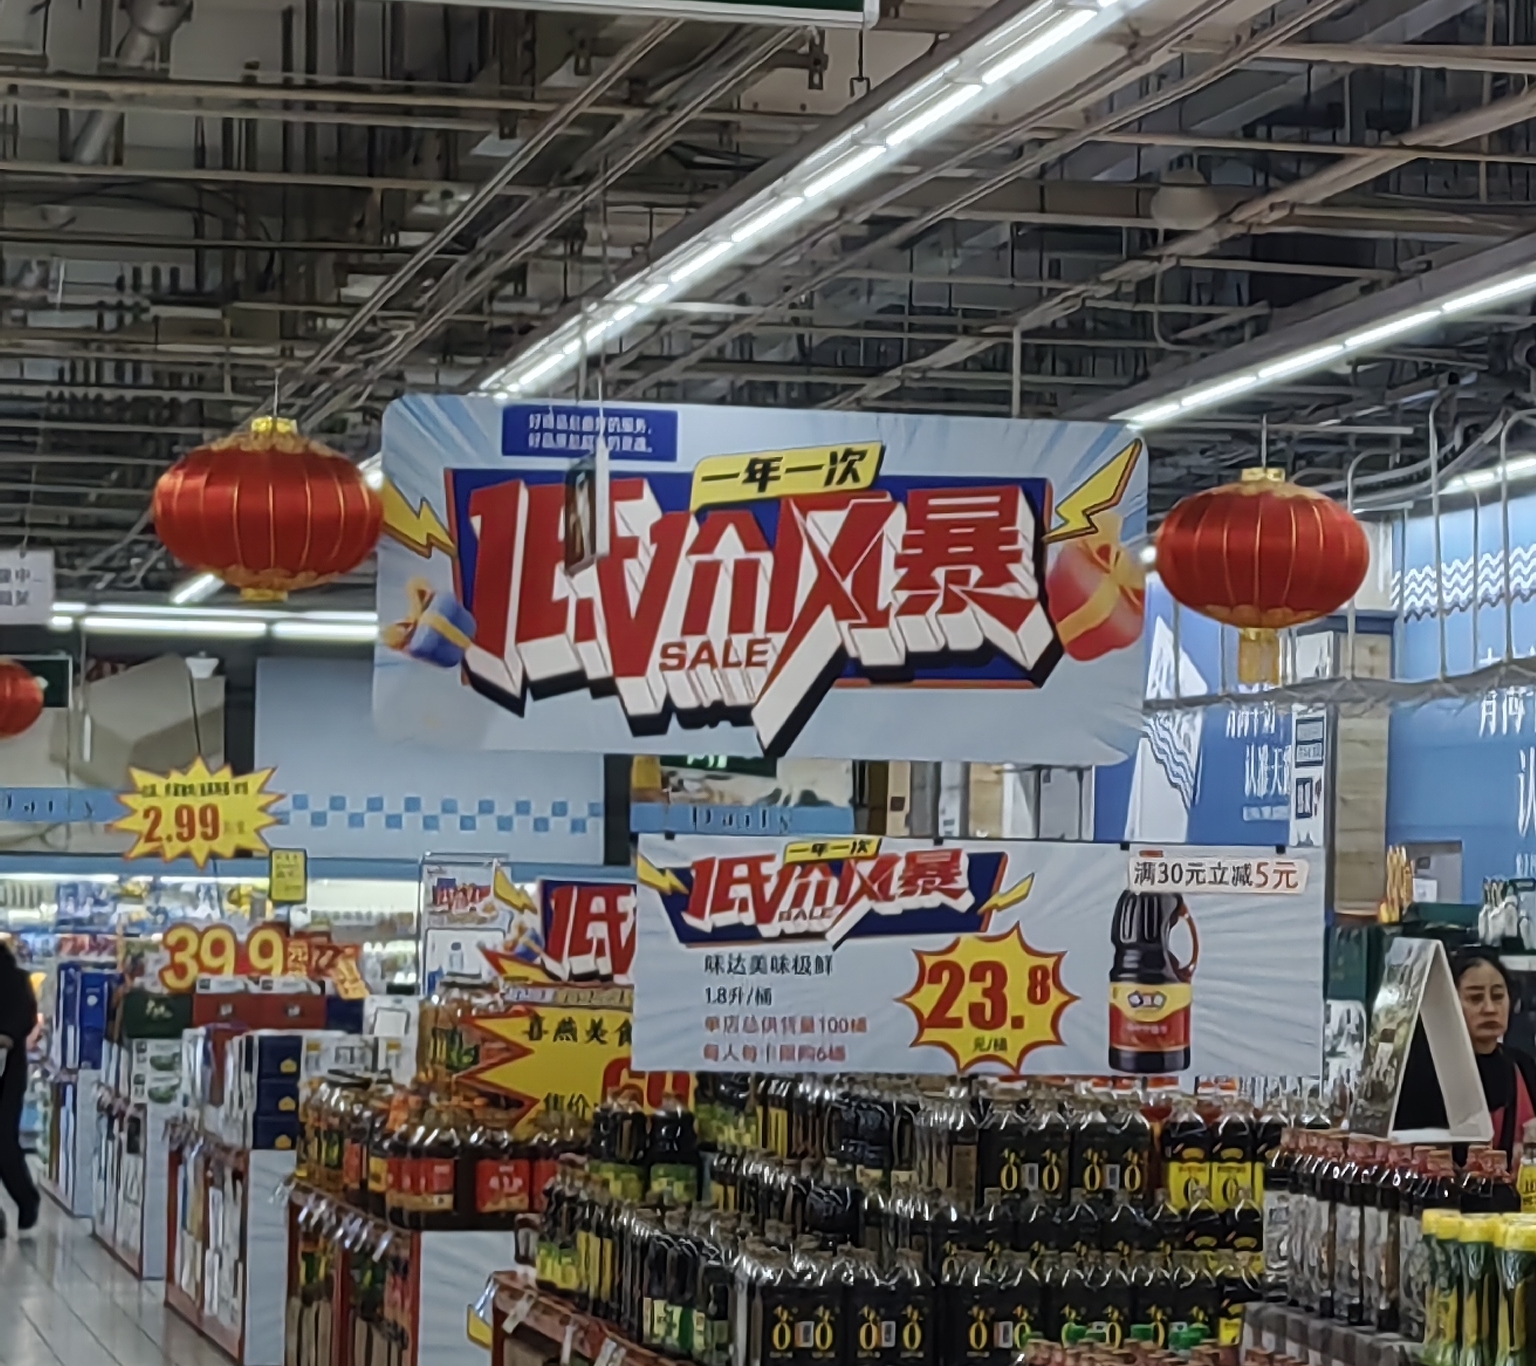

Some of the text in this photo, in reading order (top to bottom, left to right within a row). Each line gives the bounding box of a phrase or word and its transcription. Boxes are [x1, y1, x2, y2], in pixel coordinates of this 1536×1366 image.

[700, 446, 870, 487] 一年一次
[469, 475, 1042, 707] 低价风暴
[660, 638, 768, 672] SALE
[142, 804, 220, 843] 2.99
[685, 849, 974, 937] 低价风暴
[1135, 861, 1300, 889] 满30元立减5元
[704, 954, 833, 976] 味达美味极鲜
